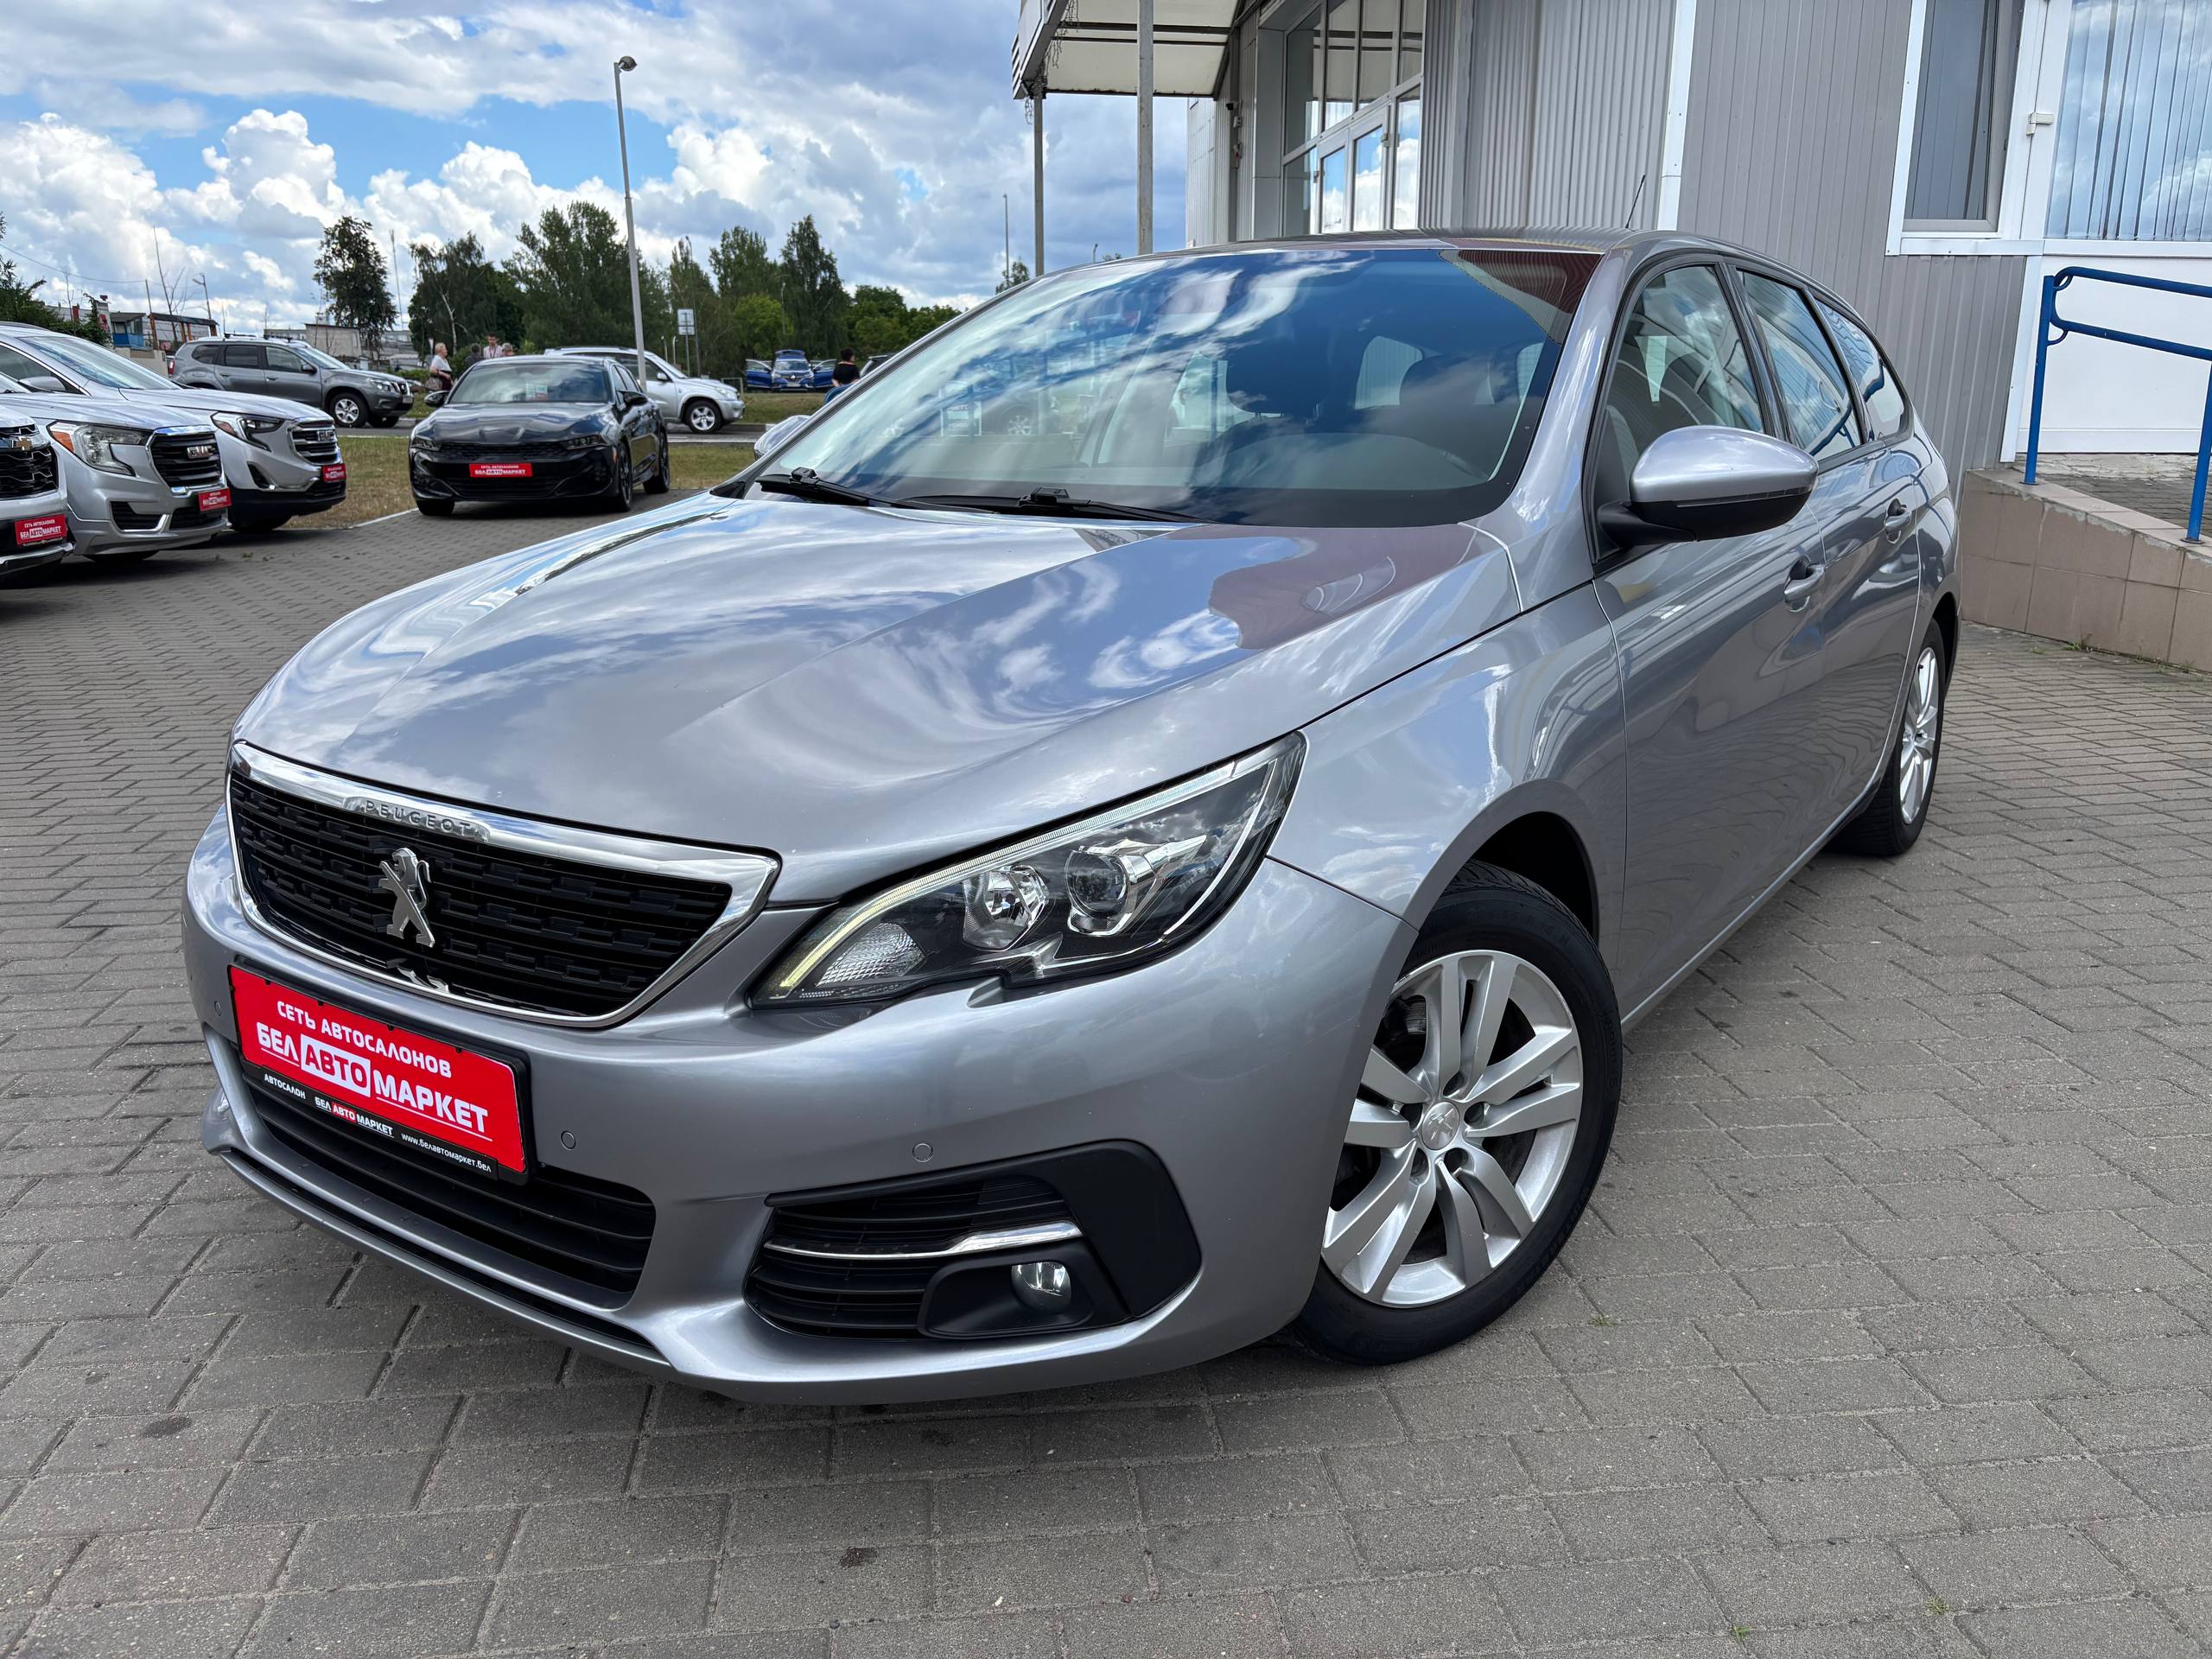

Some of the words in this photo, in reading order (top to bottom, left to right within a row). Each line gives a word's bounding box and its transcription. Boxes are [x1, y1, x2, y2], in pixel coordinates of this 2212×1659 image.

[365, 800, 471, 836] PEUGEOT
[256, 1021, 300, 1063] БЕЛ
[304, 1043, 368, 1089] АВТО
[372, 1069, 488, 1133] МАРКЕТ
[276, 1001, 316, 1030] СЕТЬ
[321, 1018, 452, 1078] АВТОСАЛОНОВ
[264, 1073, 307, 1100] АВТОСАЛОН
[315, 1096, 333, 1112] БЕЛ
[332, 1104, 356, 1122] АВТО
[356, 1114, 393, 1135] МАРКЕТ
[401, 1132, 492, 1173] www.белавтомаркет.бел
